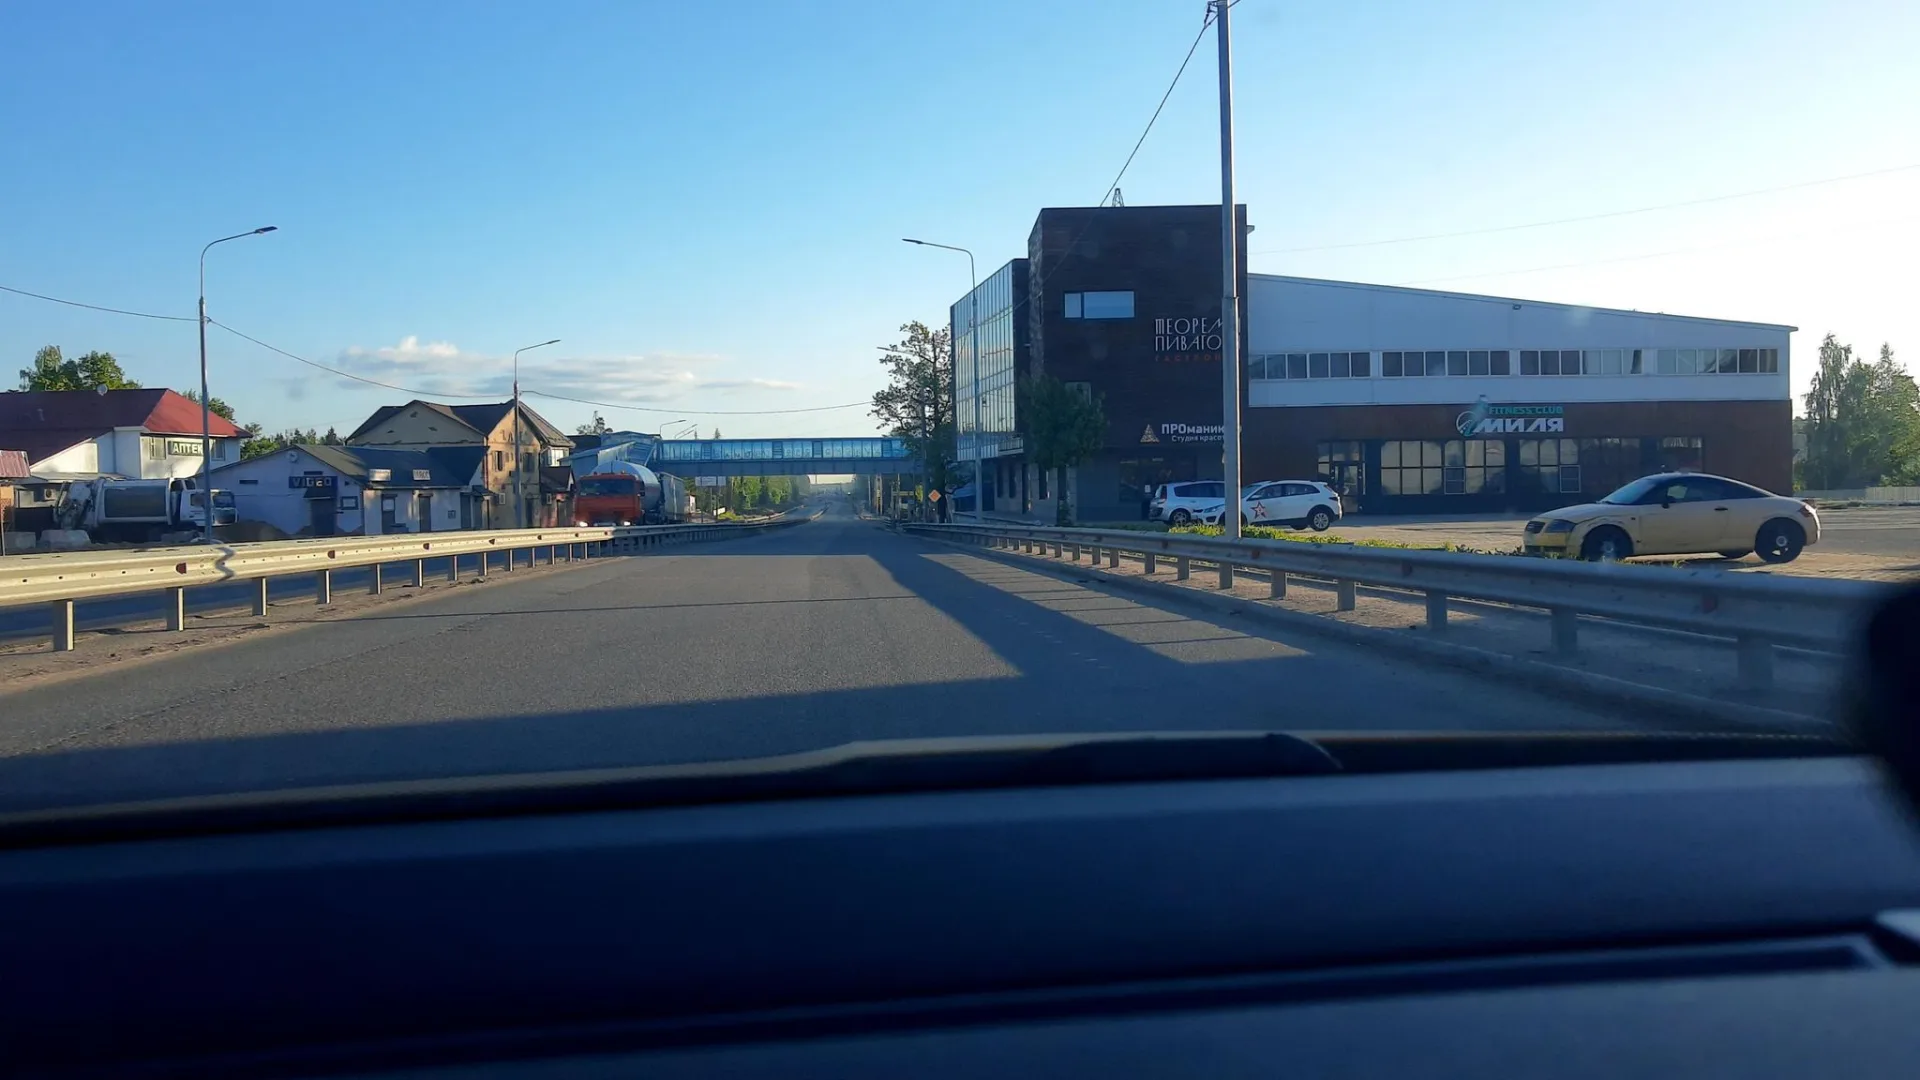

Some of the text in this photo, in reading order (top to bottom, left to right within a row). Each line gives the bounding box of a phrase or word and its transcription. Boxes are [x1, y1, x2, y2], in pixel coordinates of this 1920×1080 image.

[1155, 318, 1223, 334] ТЕОРЕМ
[1155, 335, 1222, 351] ПИВАГО
[1488, 405, 1564, 415] FITNESS CLUB
[1161, 424, 1225, 434] ПРОманик
[173, 442, 204, 454] АПТЕК
